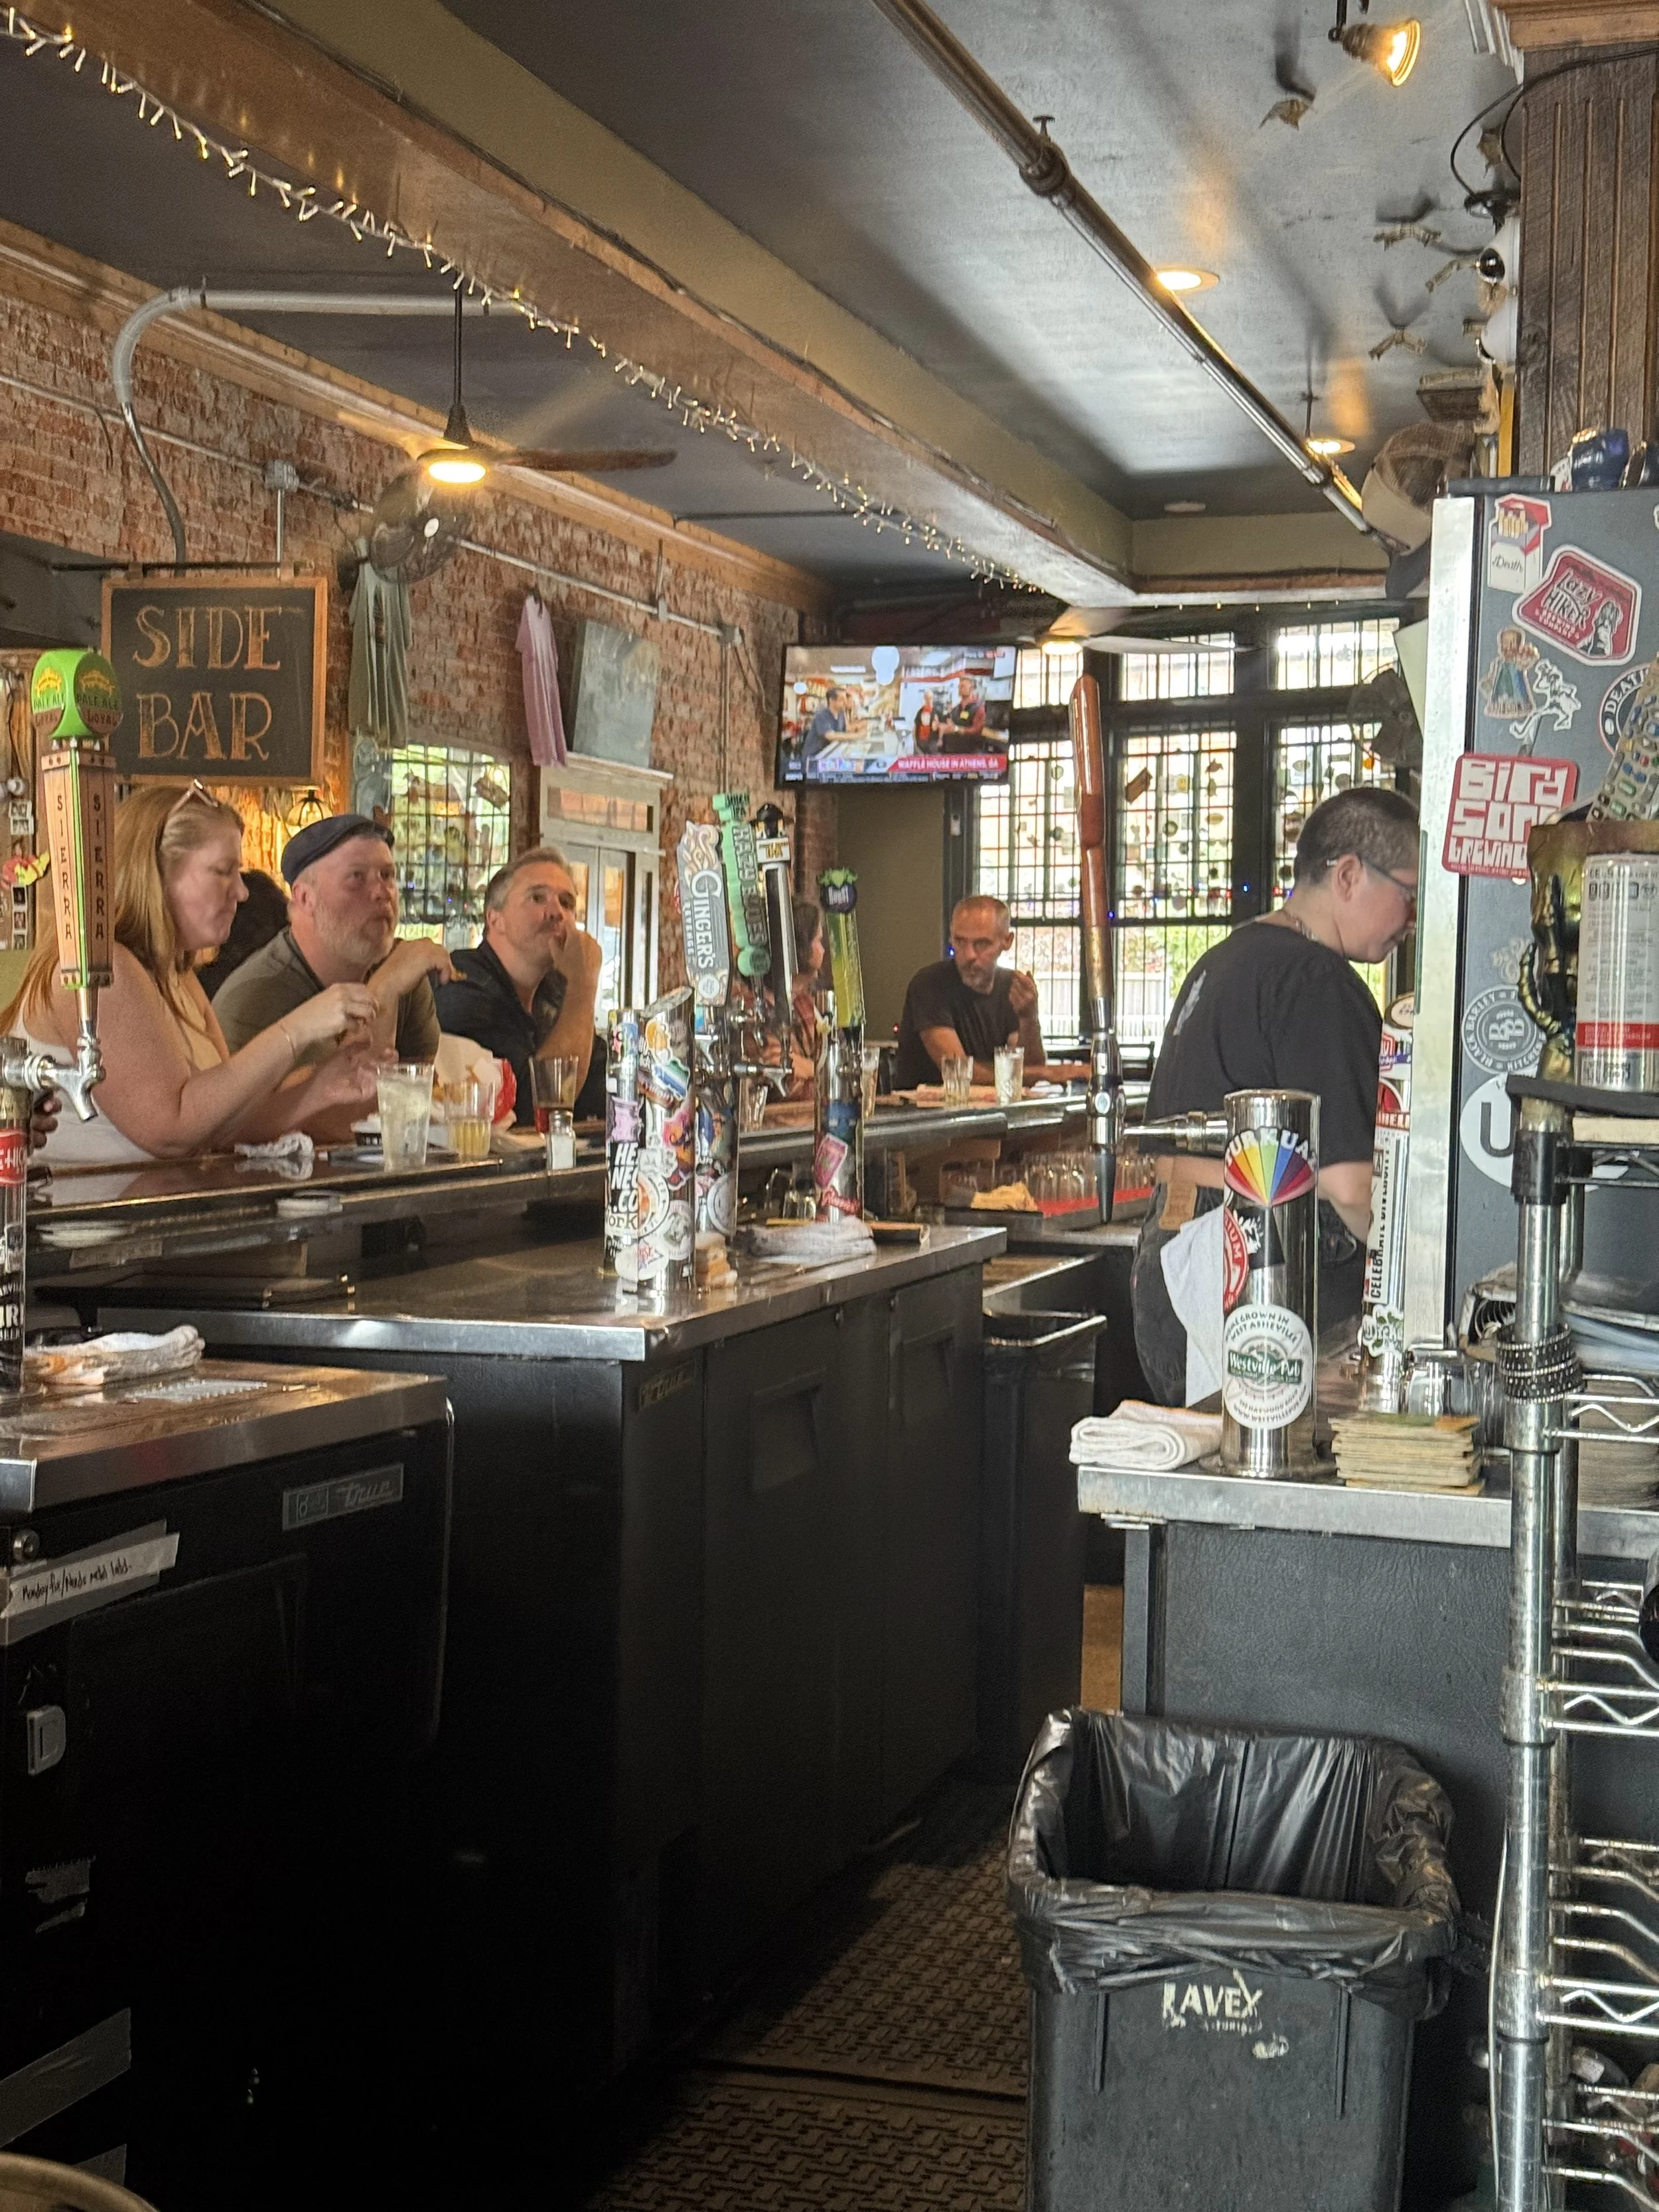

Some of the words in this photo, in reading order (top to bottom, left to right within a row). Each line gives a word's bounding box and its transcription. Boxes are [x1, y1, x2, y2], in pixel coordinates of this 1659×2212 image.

[1492, 555, 1524, 573] Death
[134, 605, 281, 670] SIDE
[77, 694, 98, 707] PALE
[102, 697, 118, 710] ALE
[137, 692, 272, 761] BAR
[57, 794, 72, 940] SIERRA
[93, 793, 104, 939] SIERRA
[682, 901, 695, 956] REVENGE
[691, 870, 723, 969] GINGER'S
[1226, 1311, 1276, 1342] HOMEGROWN
[1278, 1313, 1290, 1325] IN
[1230, 1323, 1248, 1342] WEST
[1250, 1319, 1298, 1345] ASHEVILLE
[1229, 1351, 1277, 1375] Westville
[1280, 1361, 1301, 1377] Pub
